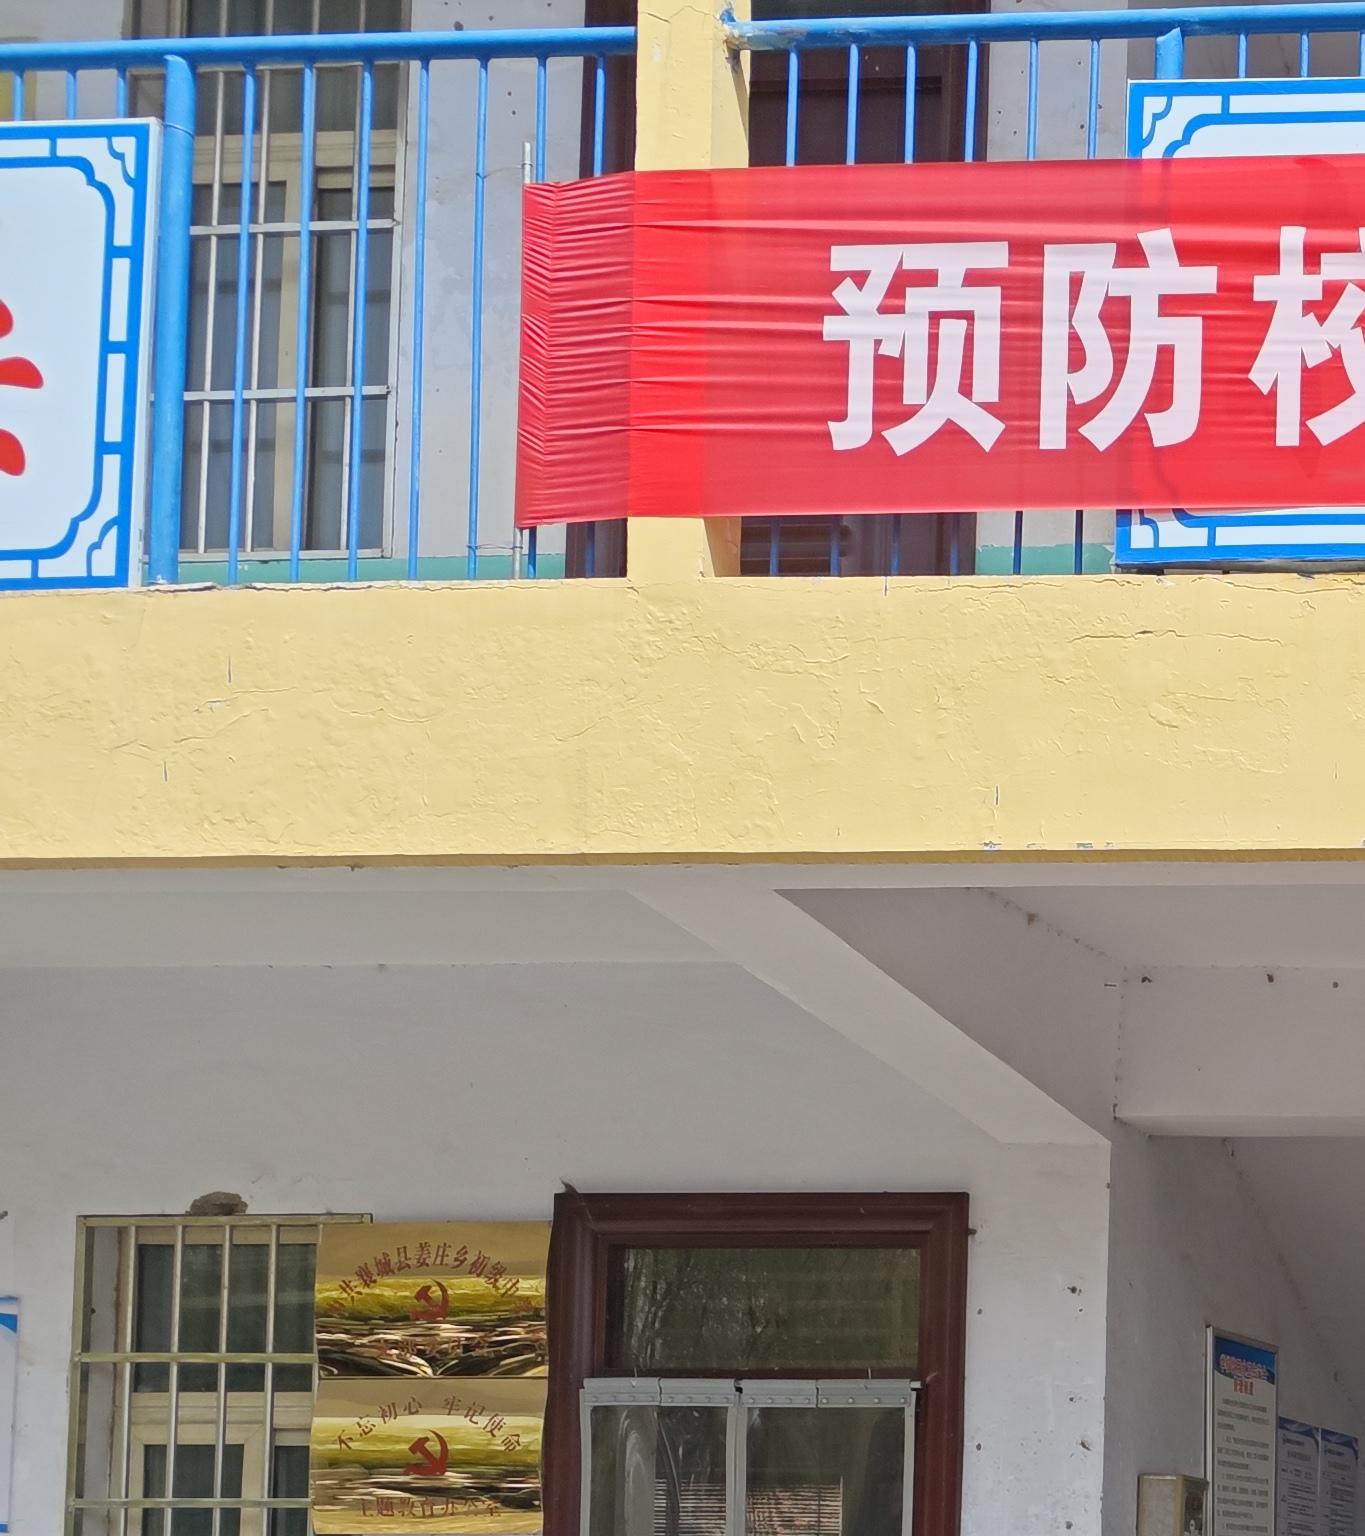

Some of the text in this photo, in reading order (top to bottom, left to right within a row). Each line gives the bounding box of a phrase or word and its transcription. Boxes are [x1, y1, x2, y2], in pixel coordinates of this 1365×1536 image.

[335, 1394, 522, 1453] 不忘初心 牢记使命
